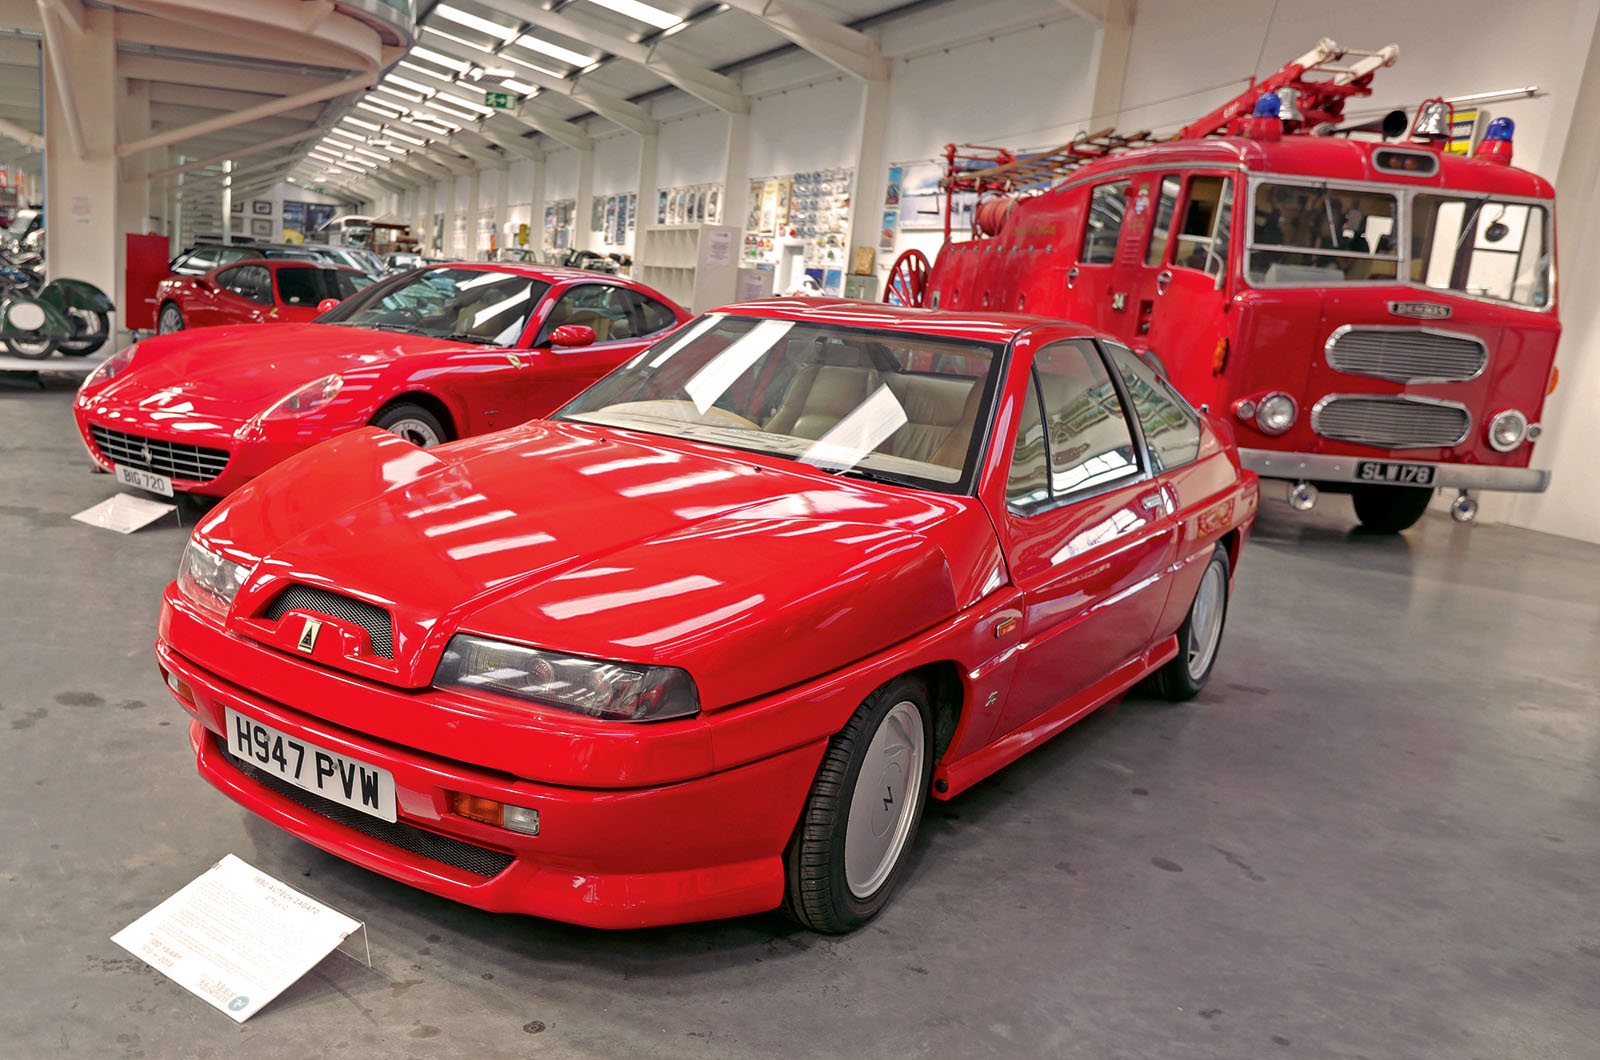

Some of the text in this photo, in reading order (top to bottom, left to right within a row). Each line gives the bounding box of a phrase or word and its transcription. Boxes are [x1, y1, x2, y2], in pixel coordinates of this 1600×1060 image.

[123, 468, 165, 491] BIG 720
[236, 715, 379, 810] H947 PVW
[268, 884, 294, 901] AUTECH
[293, 898, 321, 915] ZAGATO
